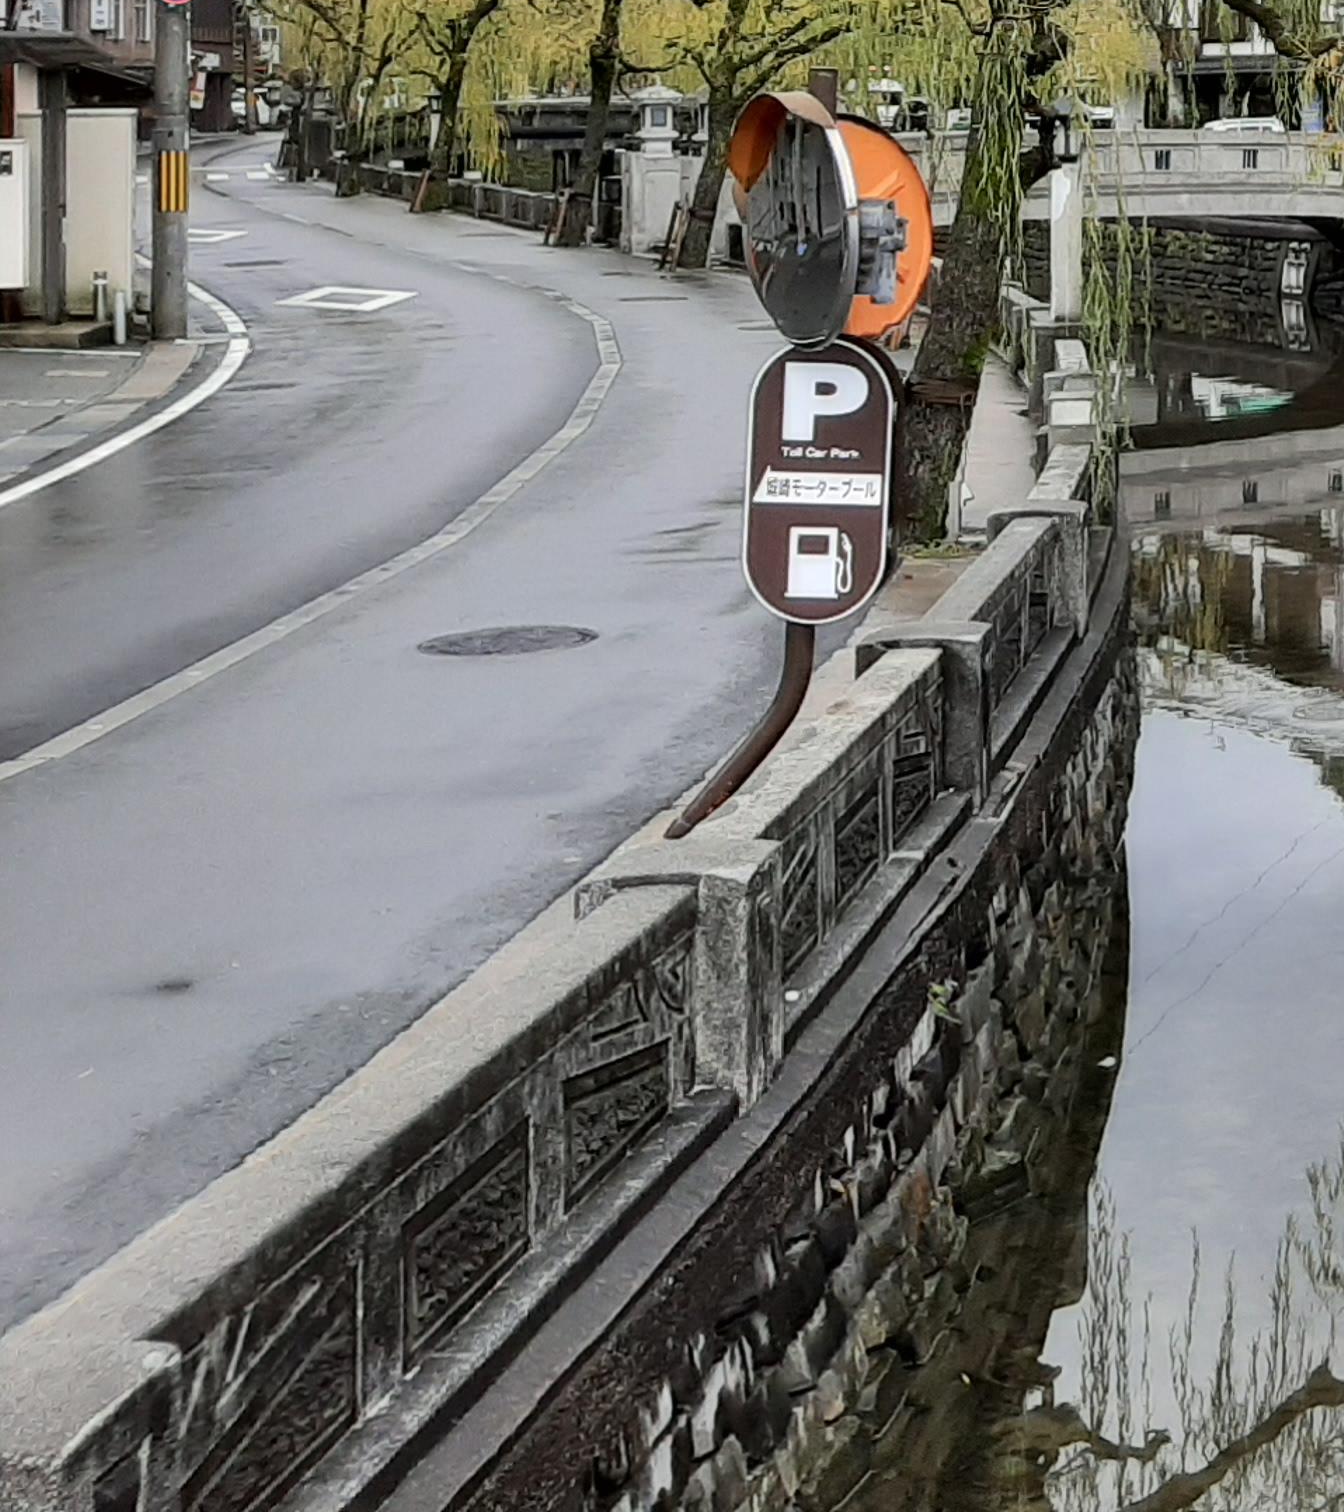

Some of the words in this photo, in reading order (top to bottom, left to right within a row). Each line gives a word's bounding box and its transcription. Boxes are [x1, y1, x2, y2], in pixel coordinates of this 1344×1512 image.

[782, 361, 869, 441] P
[805, 446, 828, 458] Car
[830, 447, 860, 459] Park
